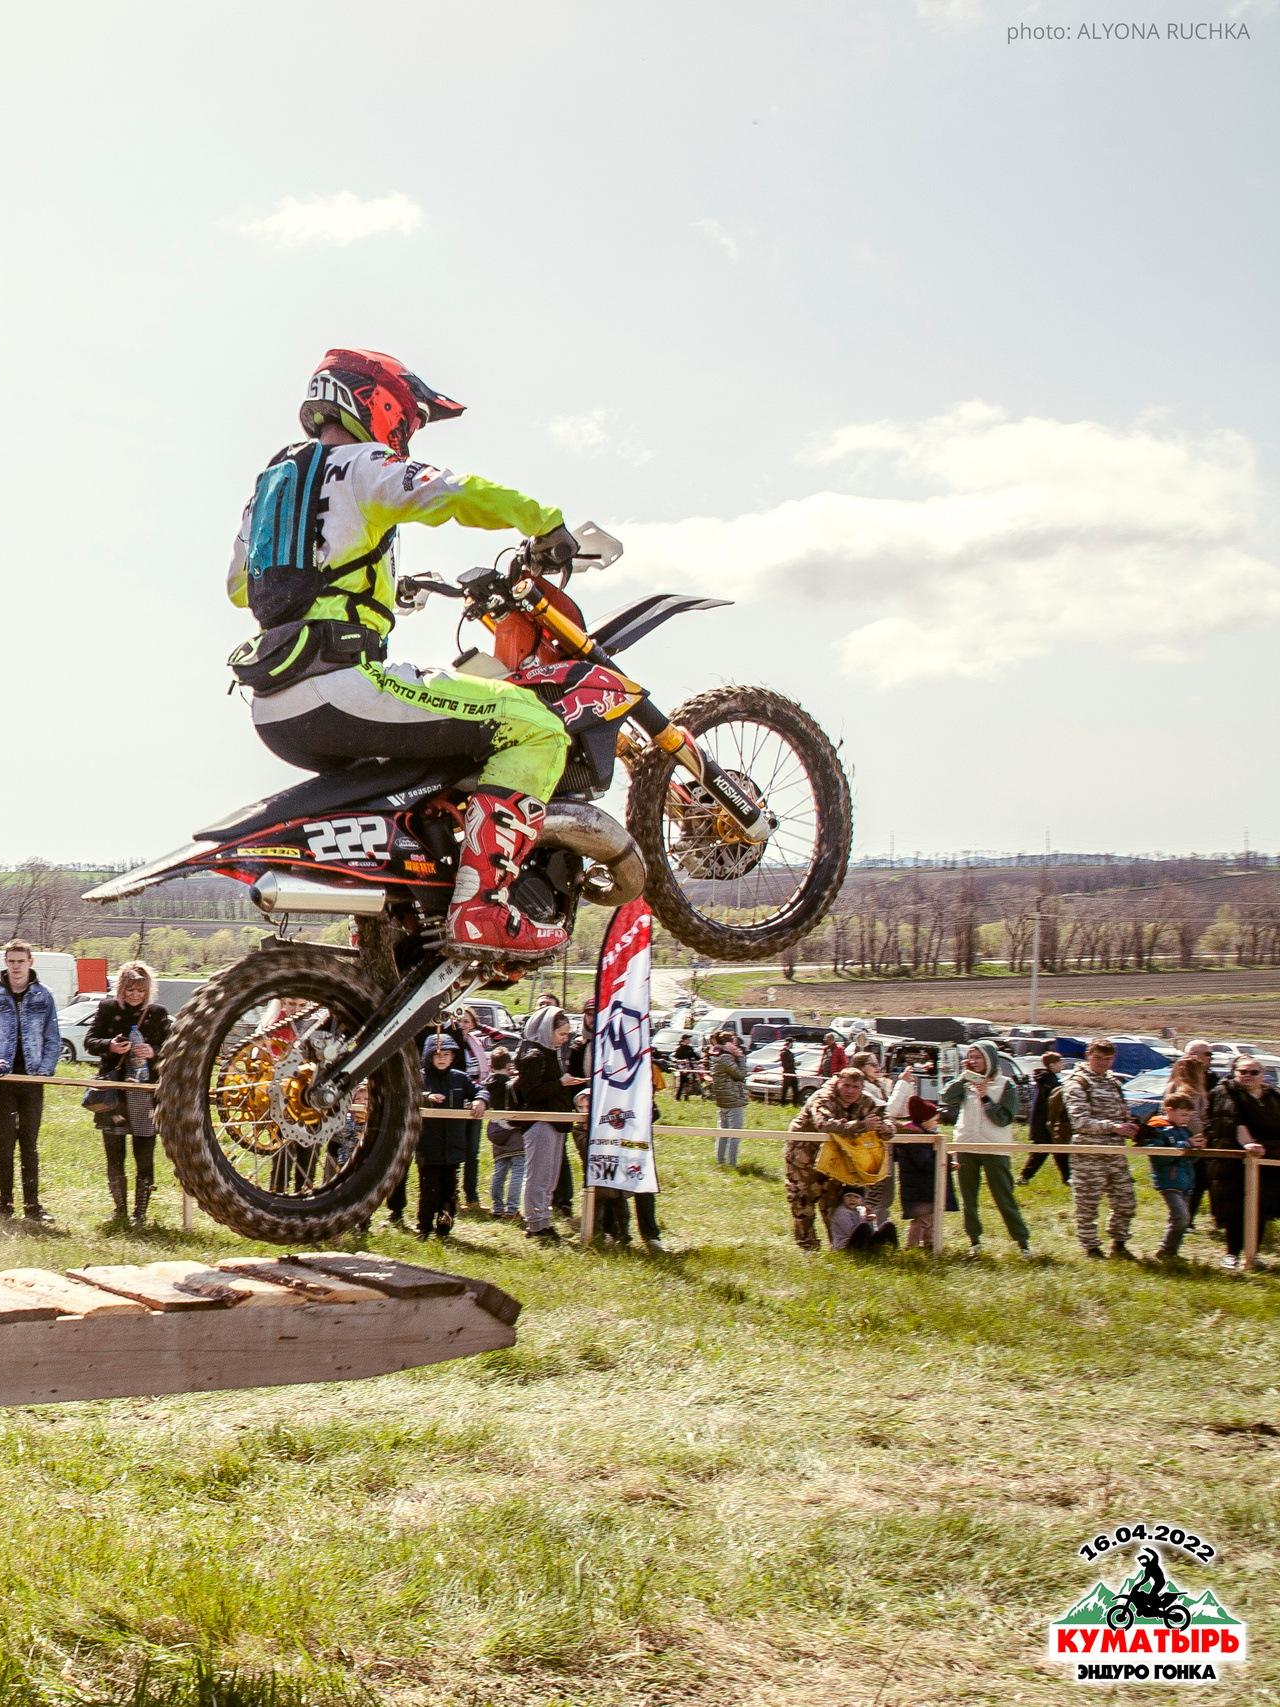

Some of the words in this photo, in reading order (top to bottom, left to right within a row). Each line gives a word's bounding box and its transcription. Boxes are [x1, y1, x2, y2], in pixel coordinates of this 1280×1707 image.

[384, 678, 417, 700] MOTO
[417, 692, 460, 712] RACING
[462, 703, 497, 716] TEAM
[712, 775, 754, 816] KOSHINE
[303, 815, 392, 863] 222
[536, 928, 564, 938] UFO
